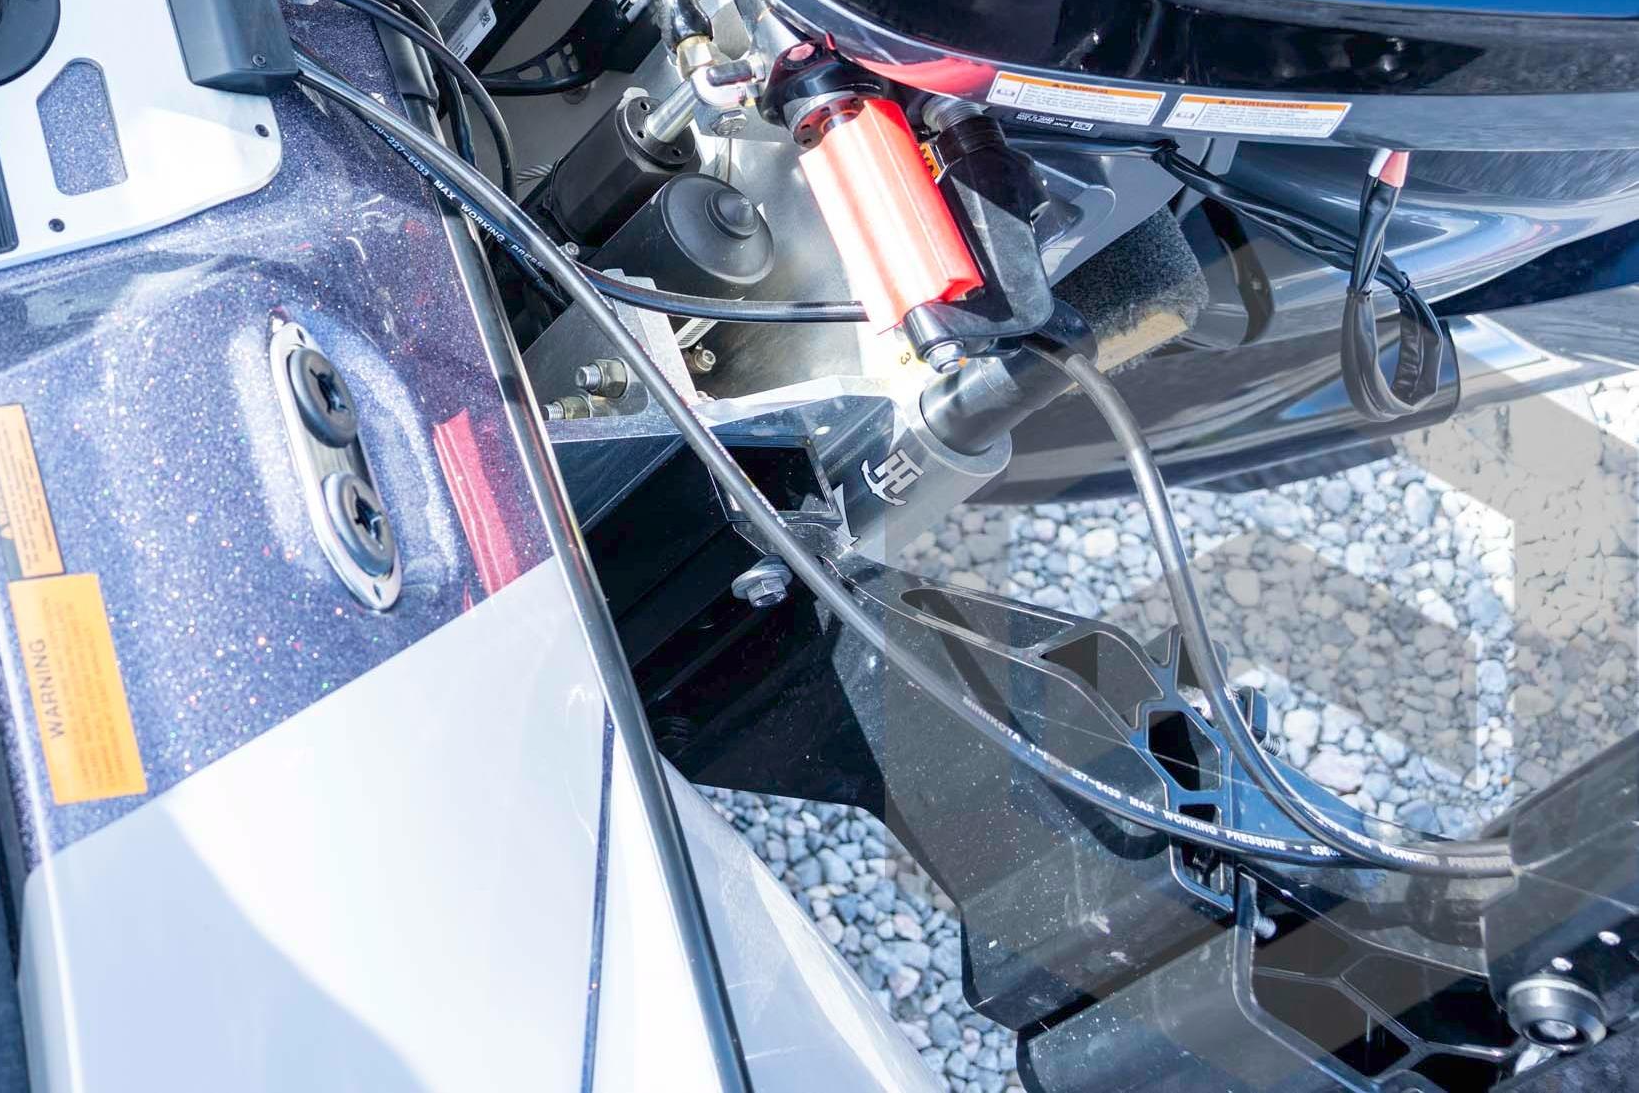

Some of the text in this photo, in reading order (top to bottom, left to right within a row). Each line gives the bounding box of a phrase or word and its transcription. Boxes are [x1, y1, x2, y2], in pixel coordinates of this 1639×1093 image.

[433, 180, 457, 200] MAX
[460, 203, 508, 243] WORKING
[29, 638, 65, 740] WARNING
[1128, 796, 1155, 815] MAX
[1162, 809, 1219, 836] WORKING
[1225, 831, 1287, 852] PRESSURE
